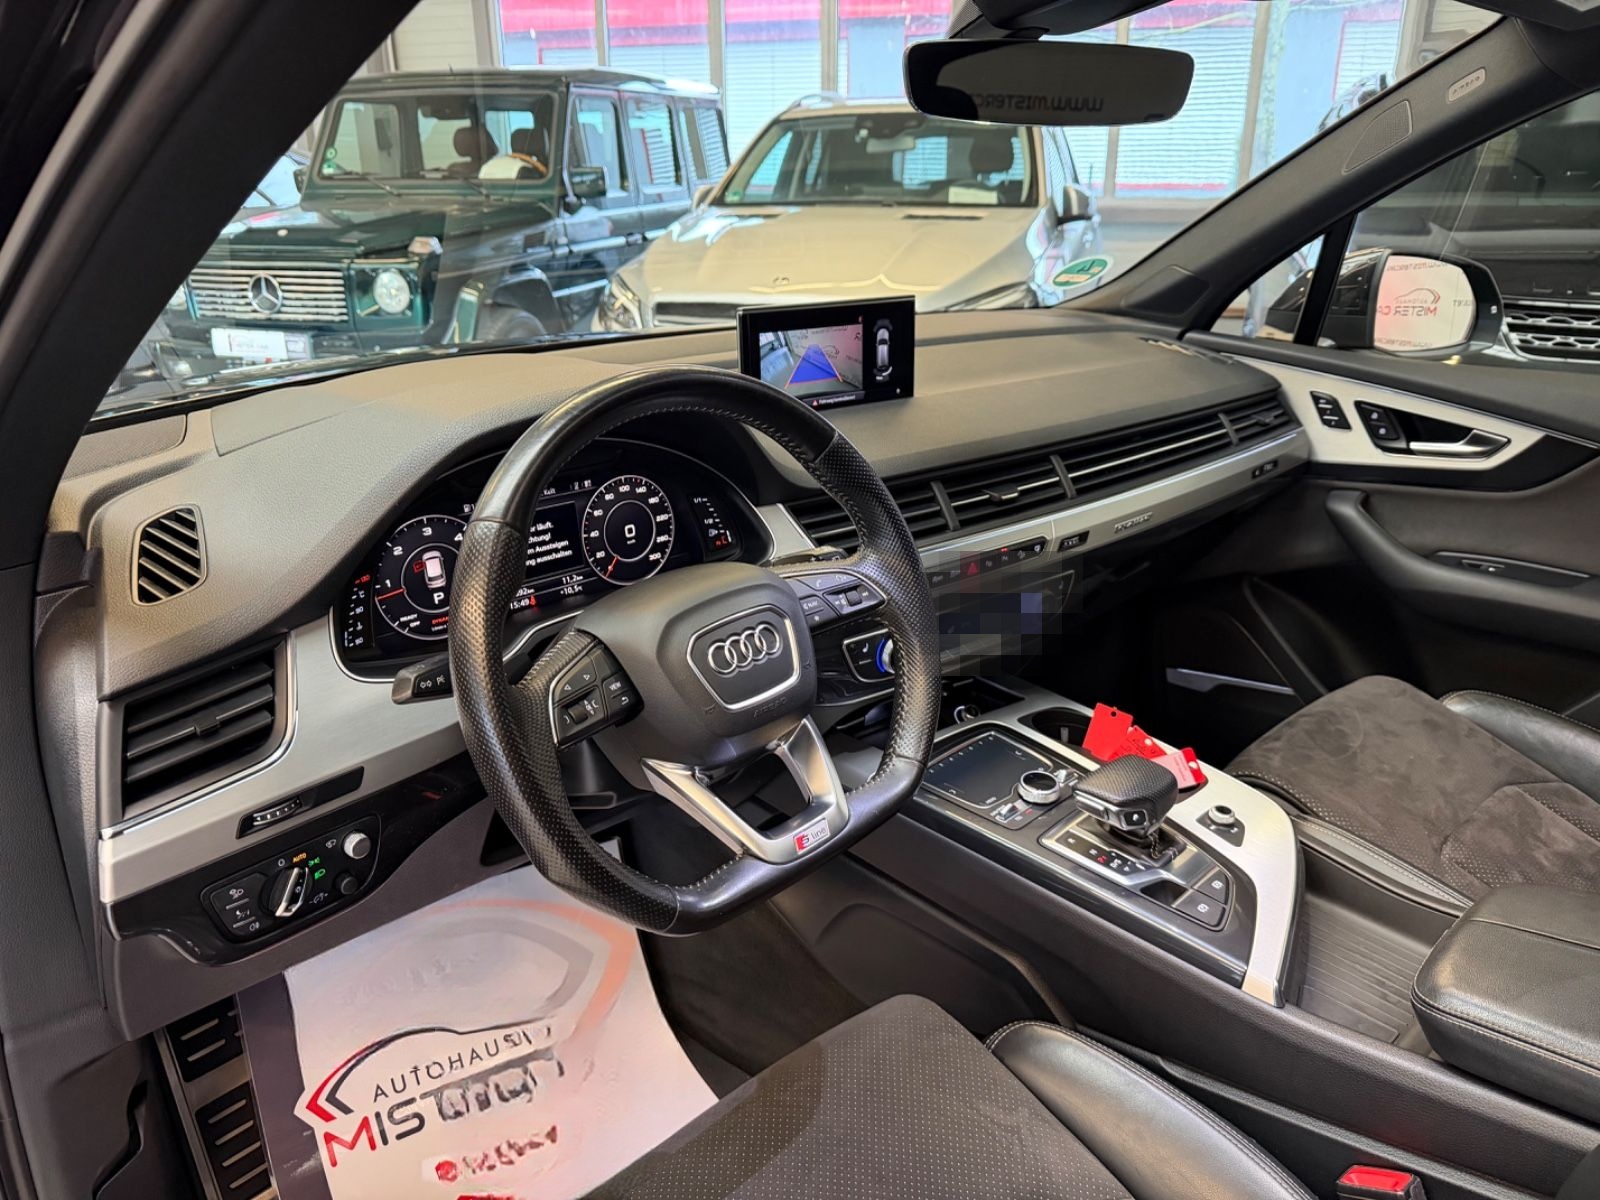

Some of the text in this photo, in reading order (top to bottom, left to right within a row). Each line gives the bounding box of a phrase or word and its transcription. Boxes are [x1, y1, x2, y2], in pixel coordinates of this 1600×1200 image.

[422, 526, 433, 536] 3
[454, 532, 464, 541] 4
[393, 546, 404, 556] 2
[385, 579, 391, 588] 1
[433, 592, 444, 605] P
